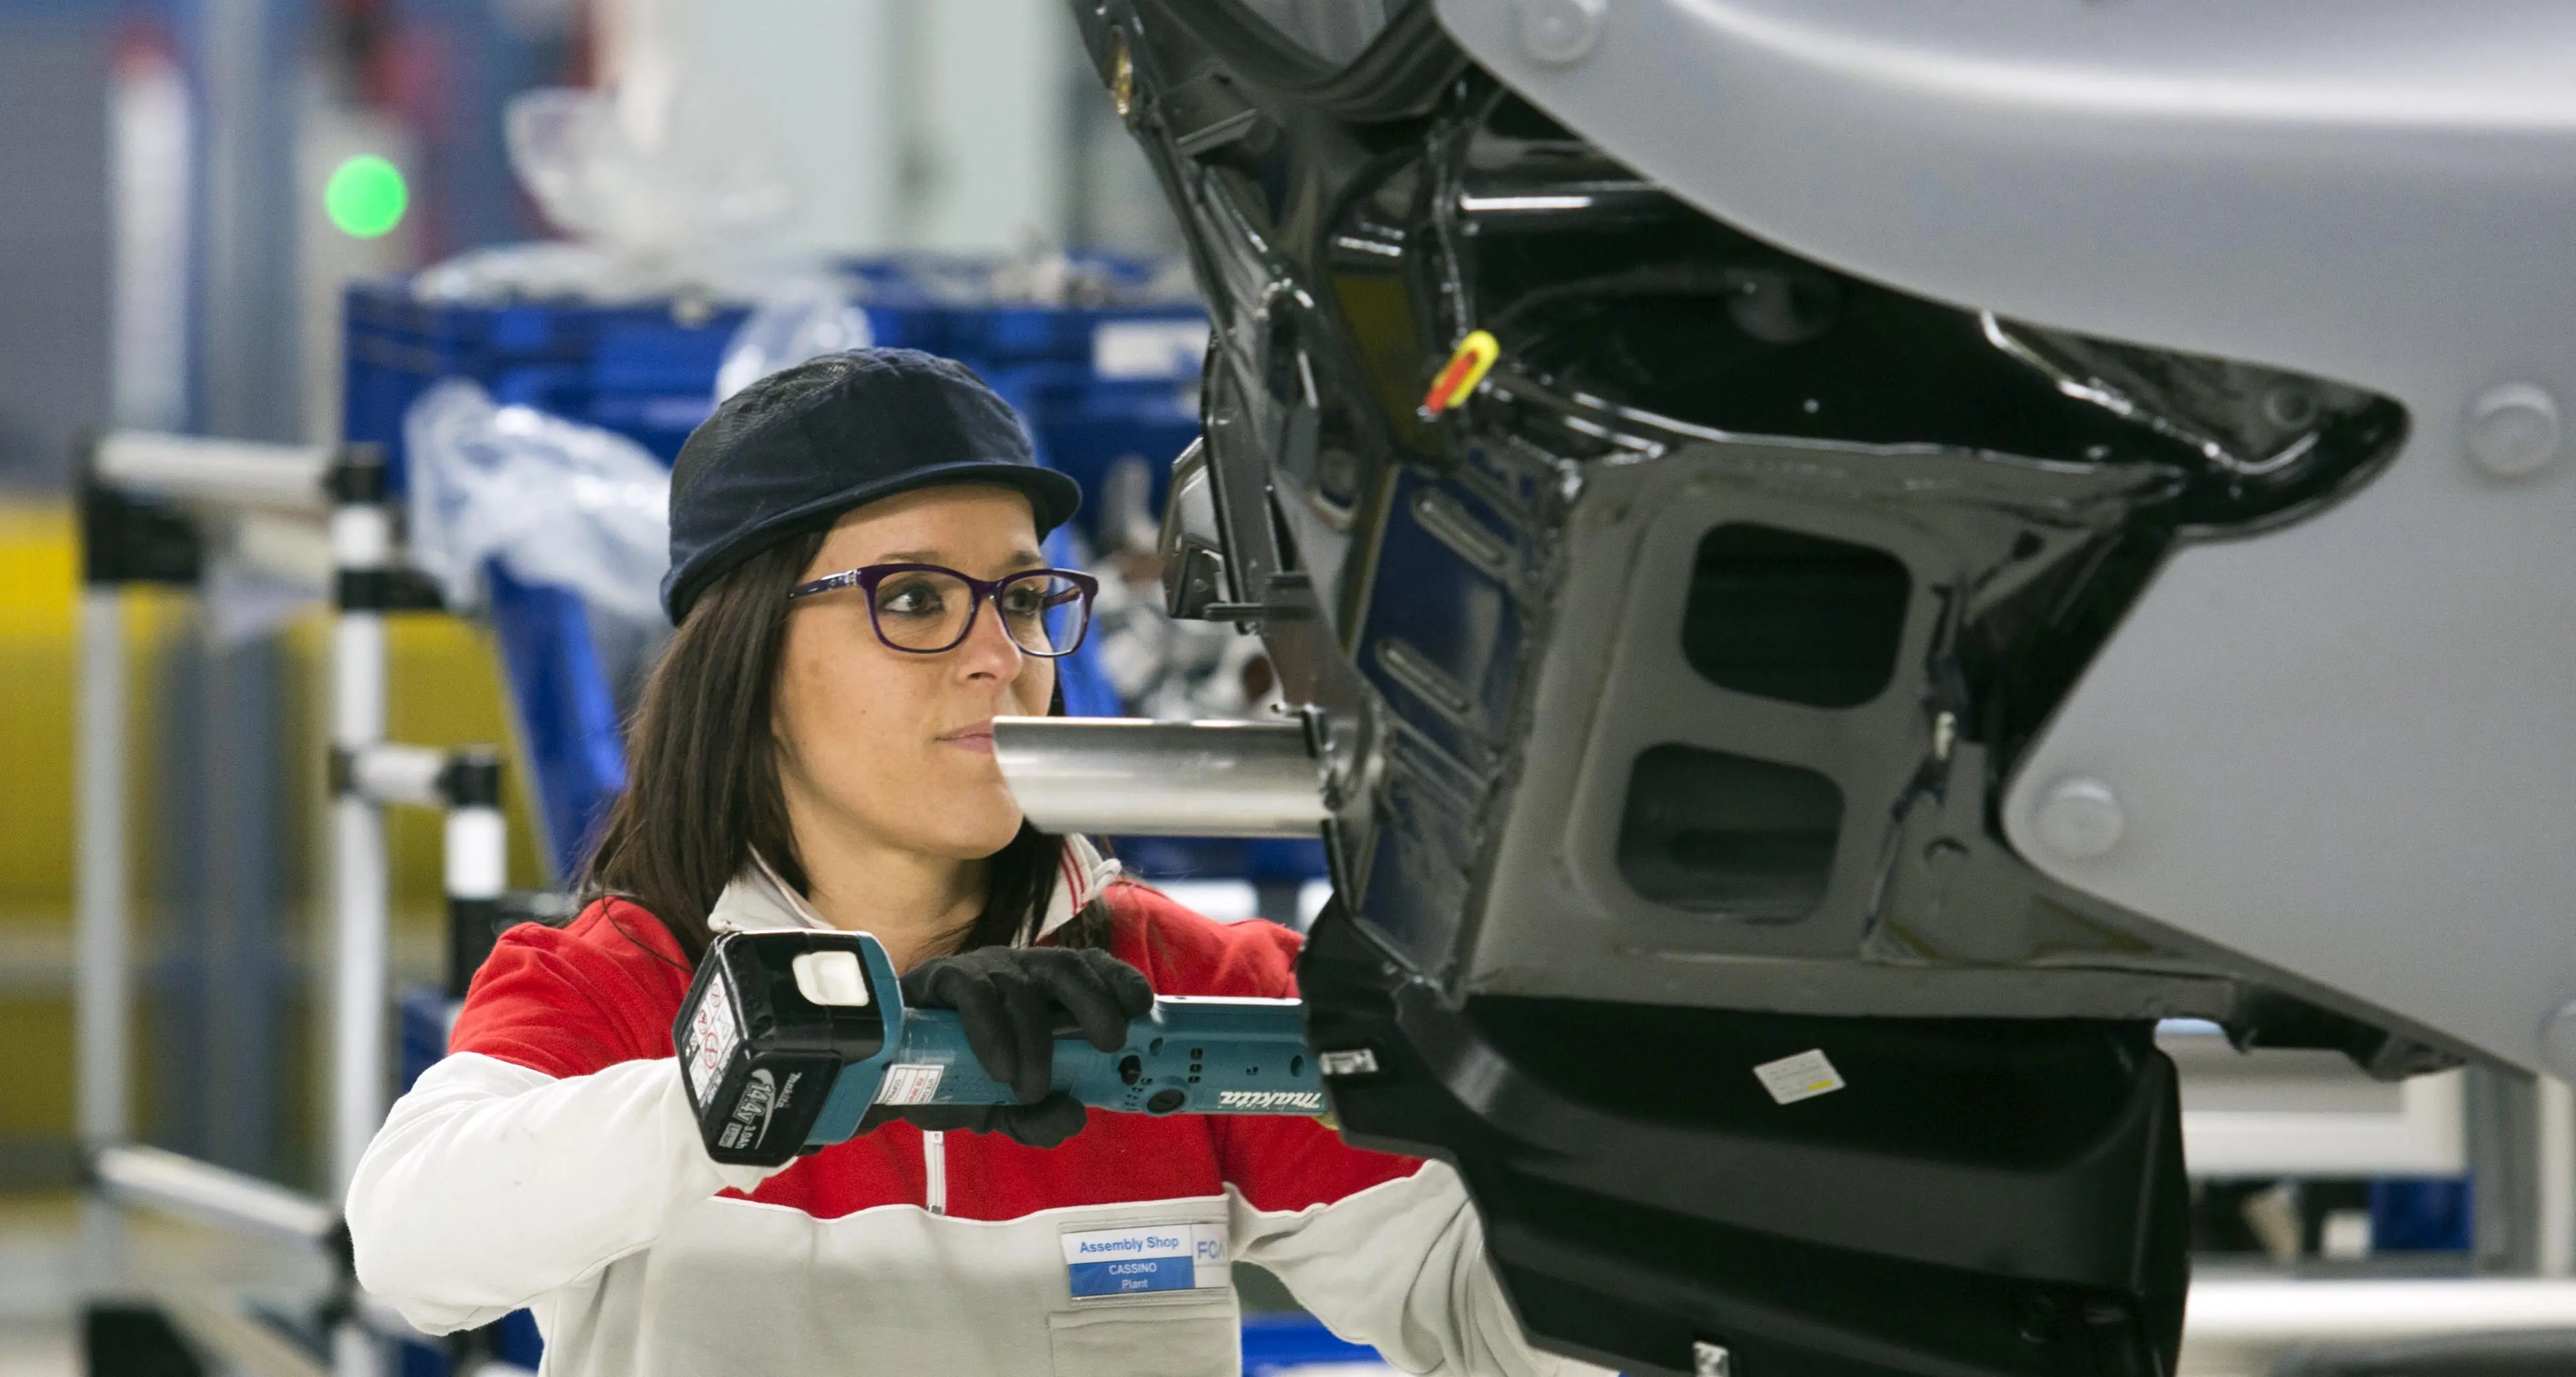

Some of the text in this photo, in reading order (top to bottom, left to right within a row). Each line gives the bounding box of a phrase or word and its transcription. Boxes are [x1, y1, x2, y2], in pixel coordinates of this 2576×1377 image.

[1220, 1091, 1322, 1109] makita
[1079, 1236, 1179, 1254] Assembly Shop
[1108, 1262, 1157, 1275] CASSINO
[1121, 1279, 1148, 1289] Plant
